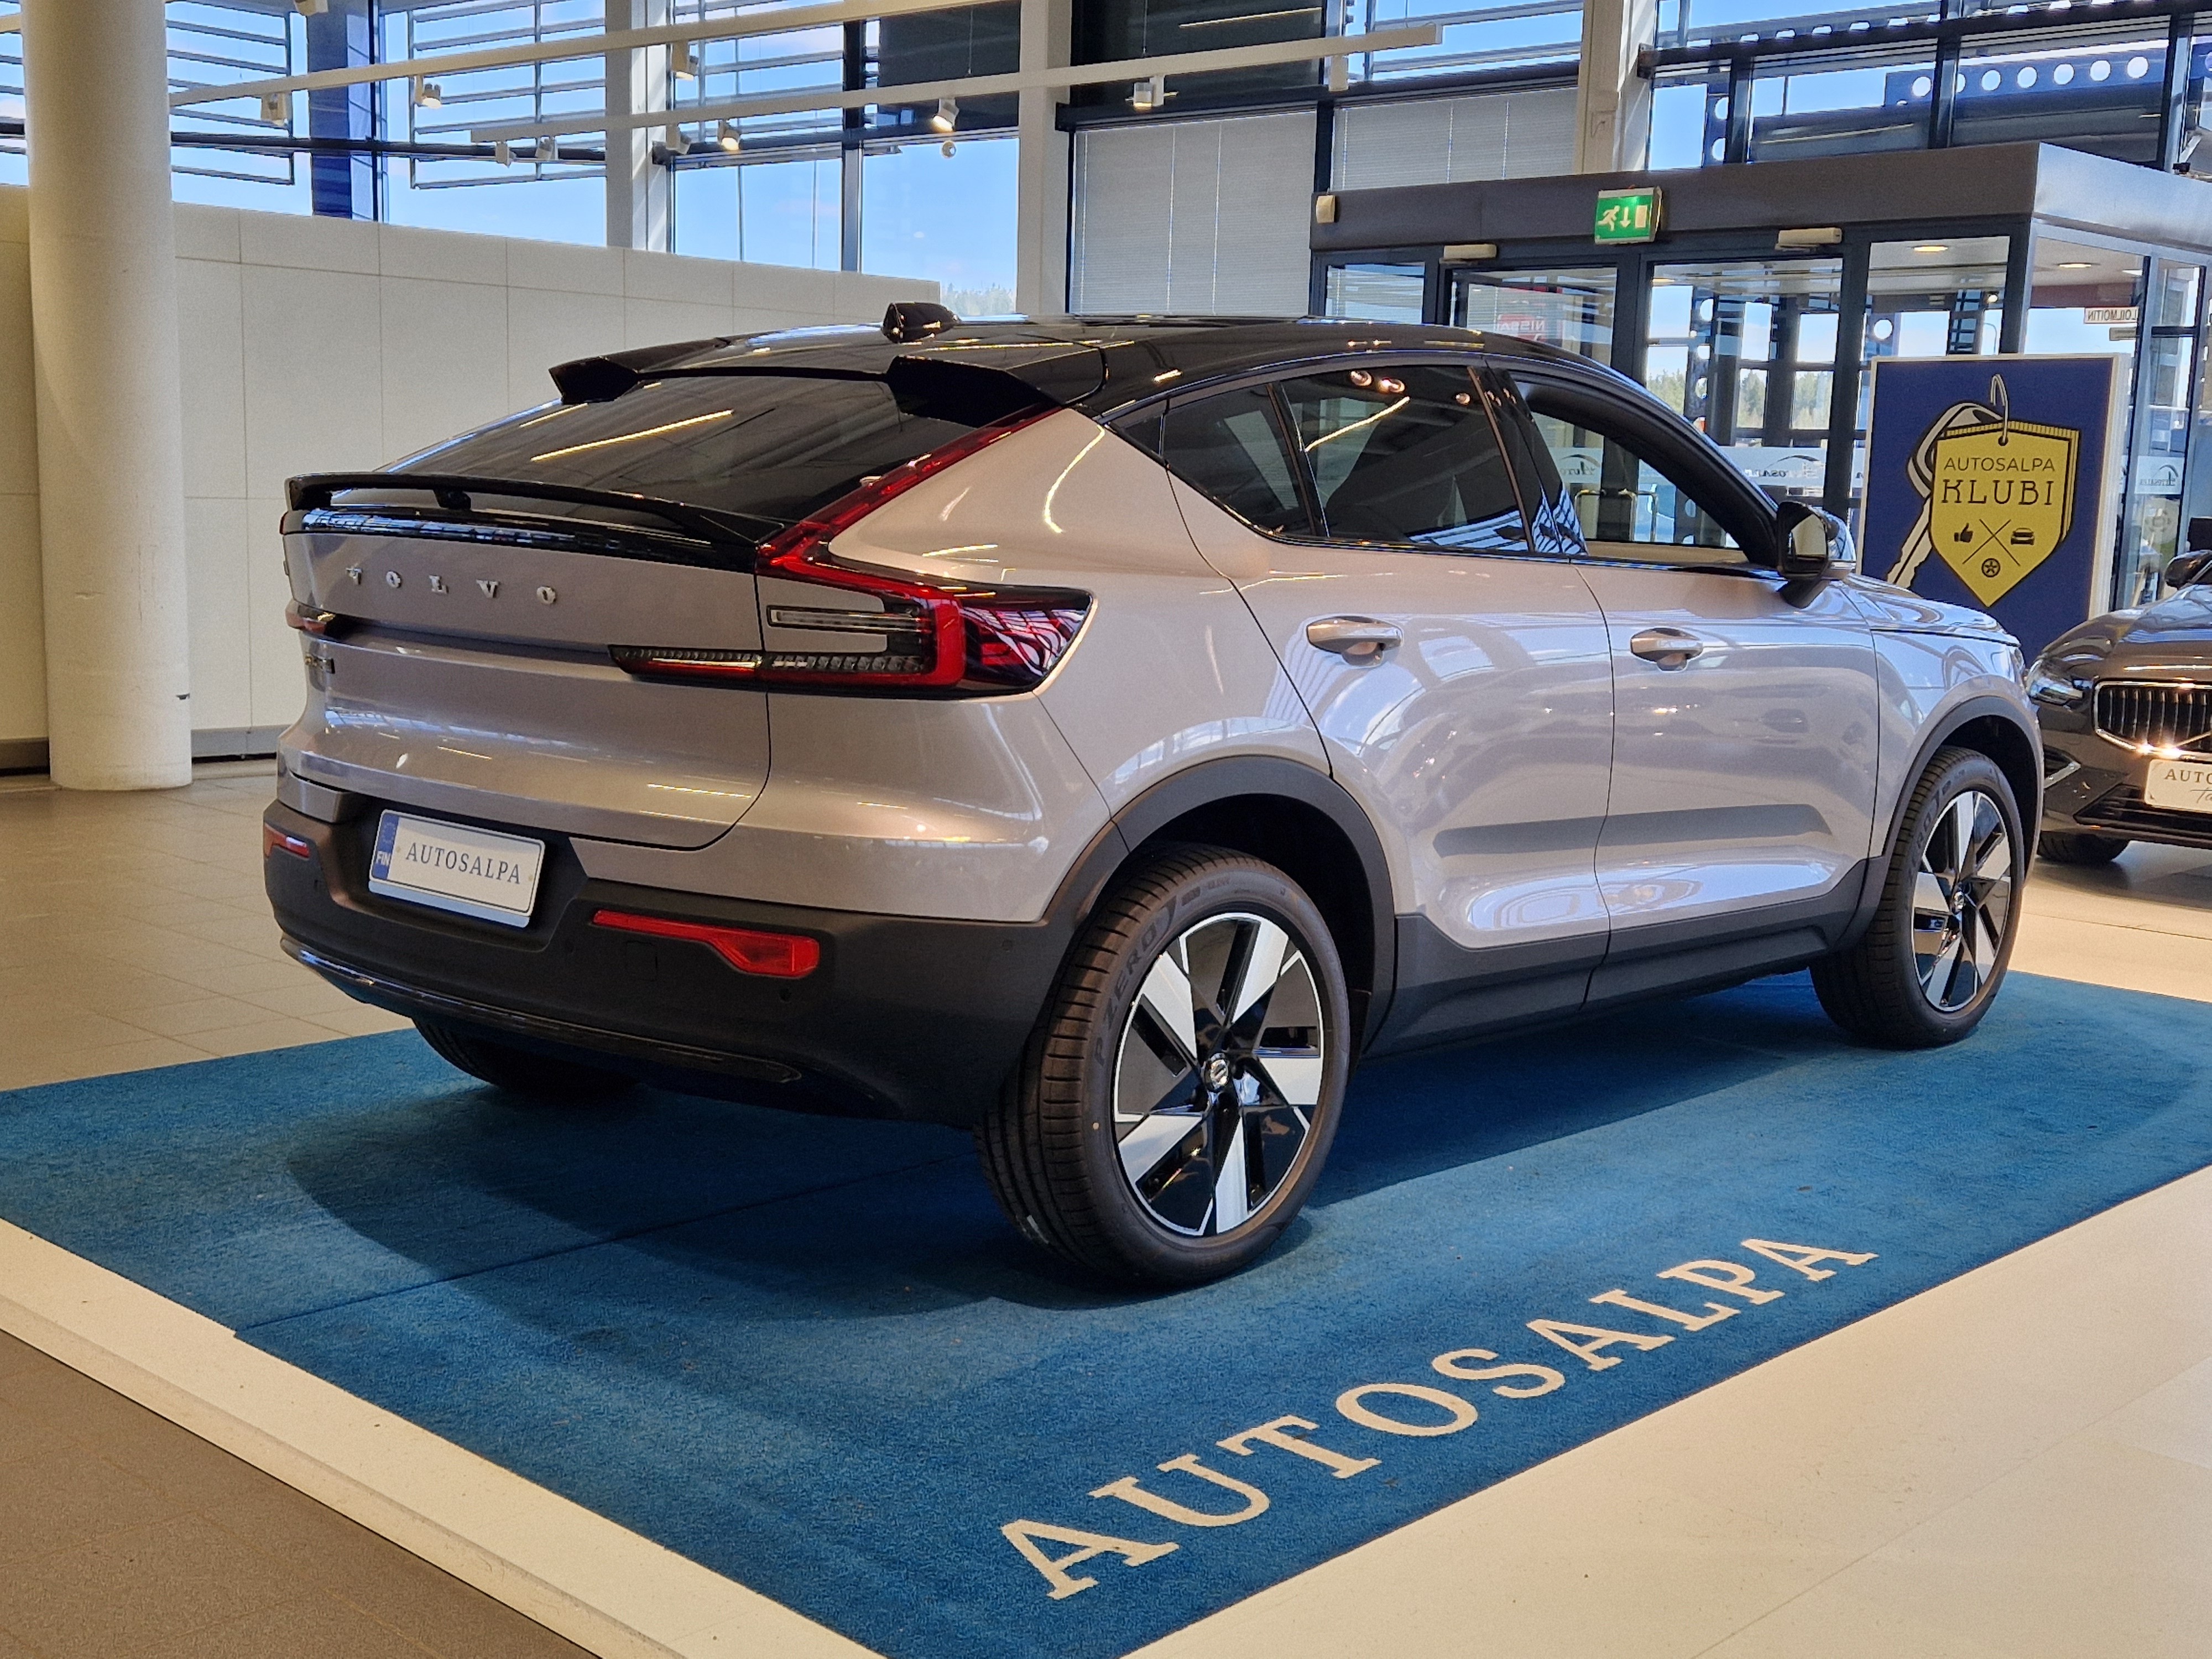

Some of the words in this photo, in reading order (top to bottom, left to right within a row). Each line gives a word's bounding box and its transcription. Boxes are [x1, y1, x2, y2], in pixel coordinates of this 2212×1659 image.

[1944, 457, 2056, 471] AUTOSALPA
[1941, 479, 2054, 505] KLUBI
[346, 567, 557, 605] VOLVO
[375, 852, 391, 866] FIN
[406, 842, 520, 884] AUTOSALPA
[1001, 1238, 1878, 1599] AUTOSALPA
